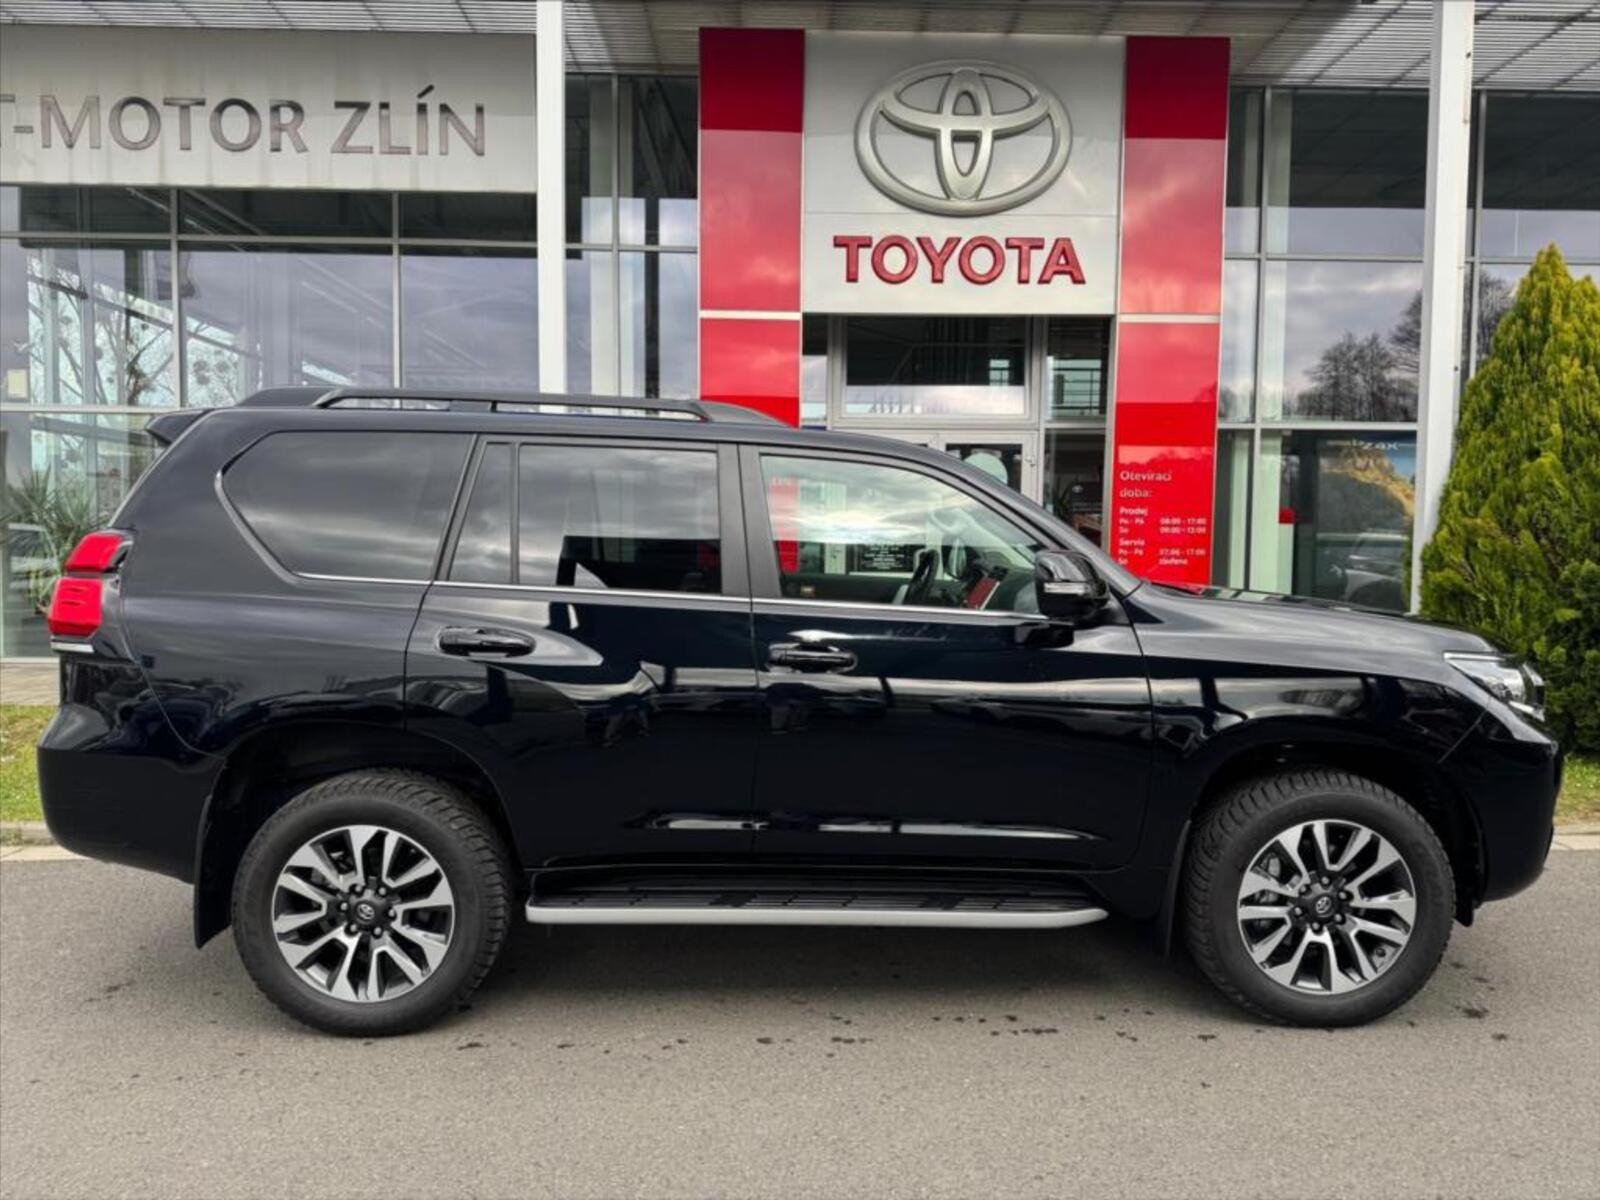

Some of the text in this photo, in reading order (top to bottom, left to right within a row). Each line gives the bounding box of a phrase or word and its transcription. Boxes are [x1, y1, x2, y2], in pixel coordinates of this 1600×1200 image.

[330, 84, 486, 157] ZLÍN
[833, 235, 1086, 285] TOYOTA
[1119, 487, 1153, 498] doba:
[1119, 506, 1149, 516] Prodej
[1119, 537, 1145, 546] Servis
